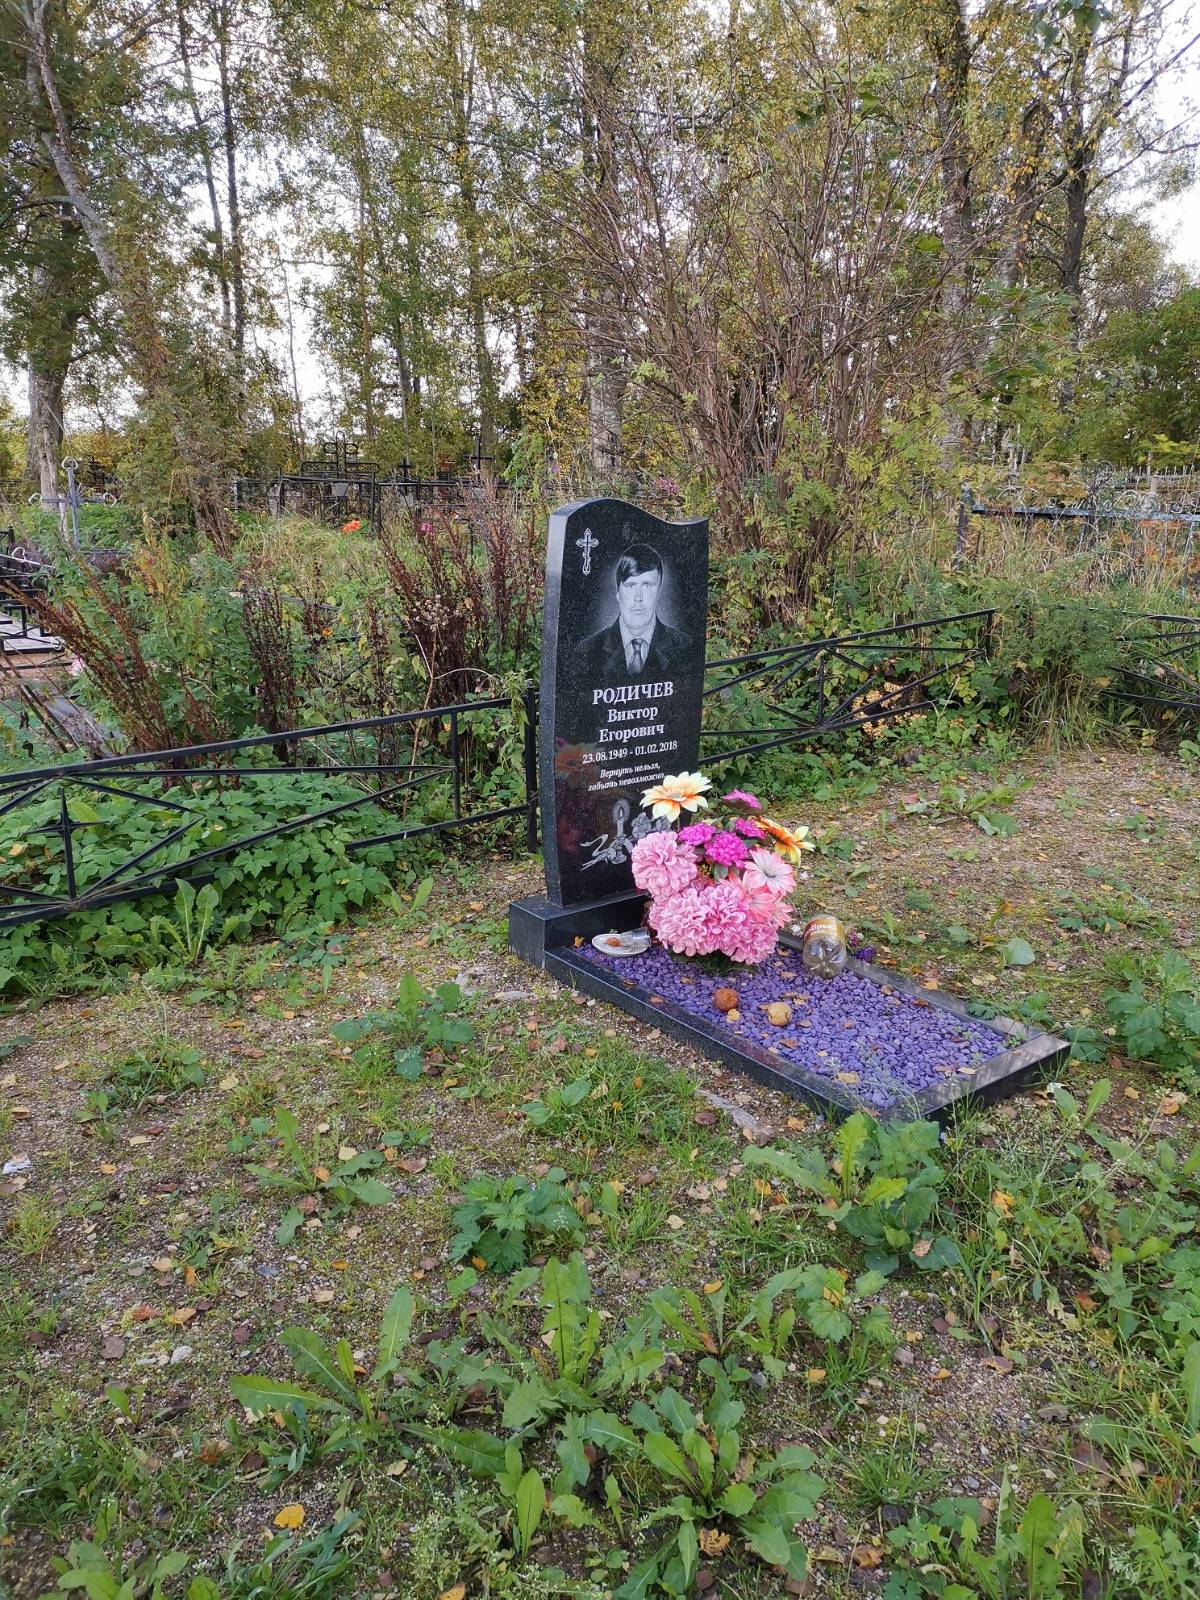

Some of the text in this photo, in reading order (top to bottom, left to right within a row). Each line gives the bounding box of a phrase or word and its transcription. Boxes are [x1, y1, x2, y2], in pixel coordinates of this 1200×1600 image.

[592, 681, 674, 705] РОДИЧЕВ
[608, 707, 658, 722] Виктор
[598, 724, 665, 743] Егорович
[582, 748, 628, 764] 23.08.1949
[635, 740, 678, 756] 01.02.2018
[600, 767, 633, 779] Вернуть
[587, 779, 617, 792] забыть
